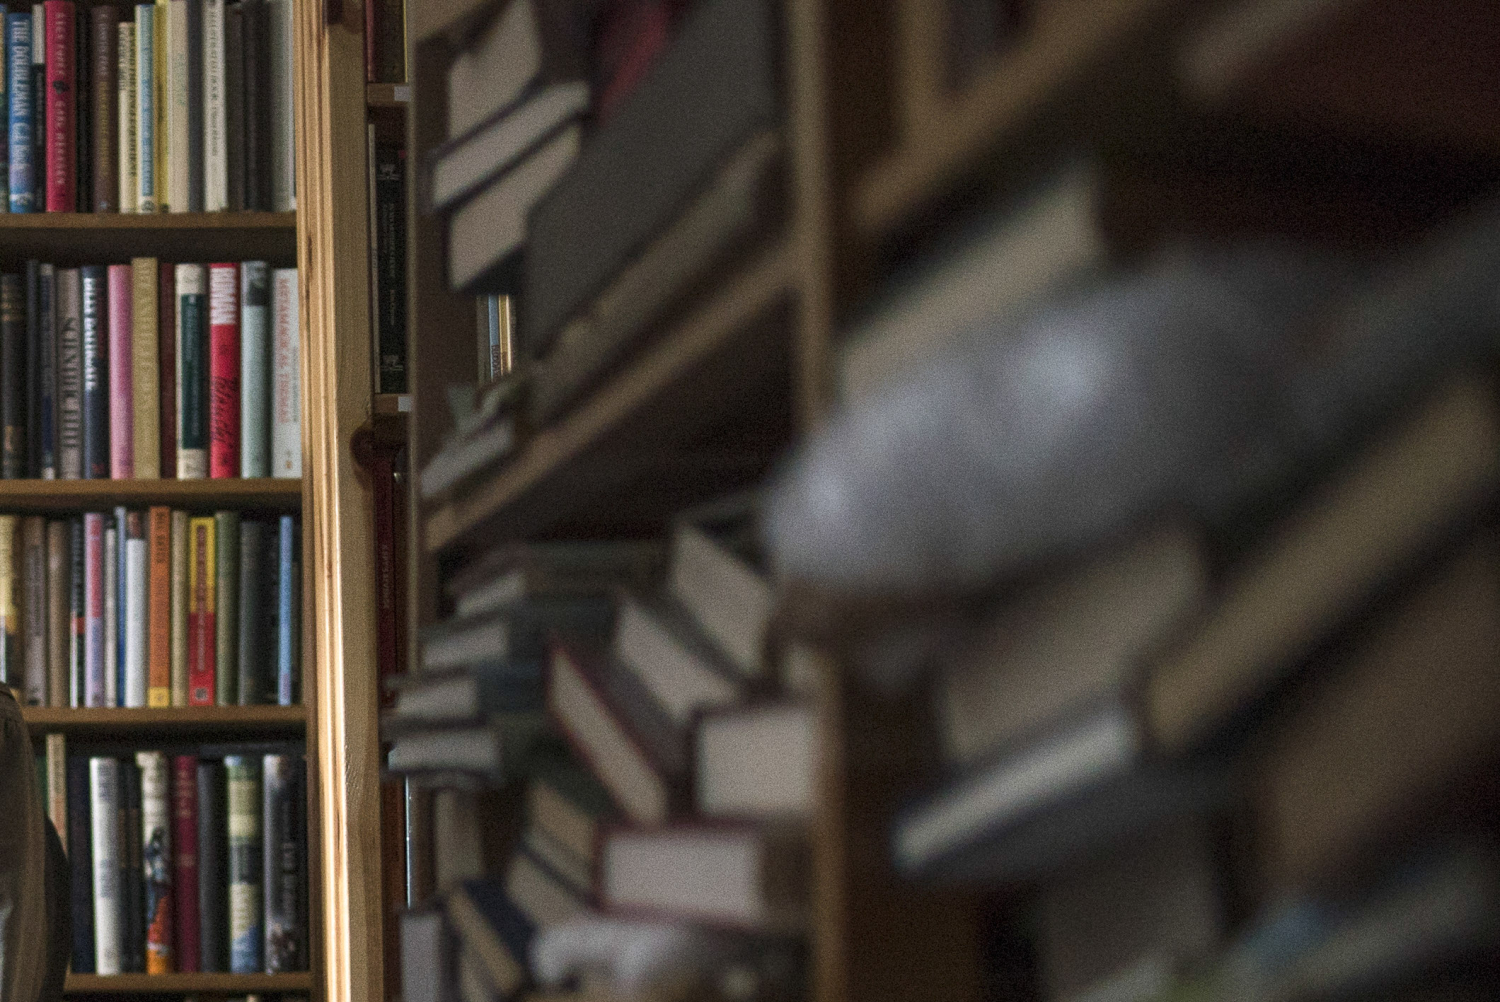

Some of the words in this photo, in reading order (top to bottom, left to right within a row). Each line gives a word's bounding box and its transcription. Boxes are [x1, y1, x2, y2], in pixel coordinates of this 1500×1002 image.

[11, 20, 31, 43] THE
[11, 46, 31, 116] DOUBLEMAN
[84, 278, 98, 314] BILLY
[210, 267, 237, 326] ROMAN
[278, 278, 291, 369] METAMAGICAL
[62, 317, 80, 404] SCIENTIFIC
[84, 317, 98, 392] BATHGATE
[278, 373, 291, 424] THEMAS
